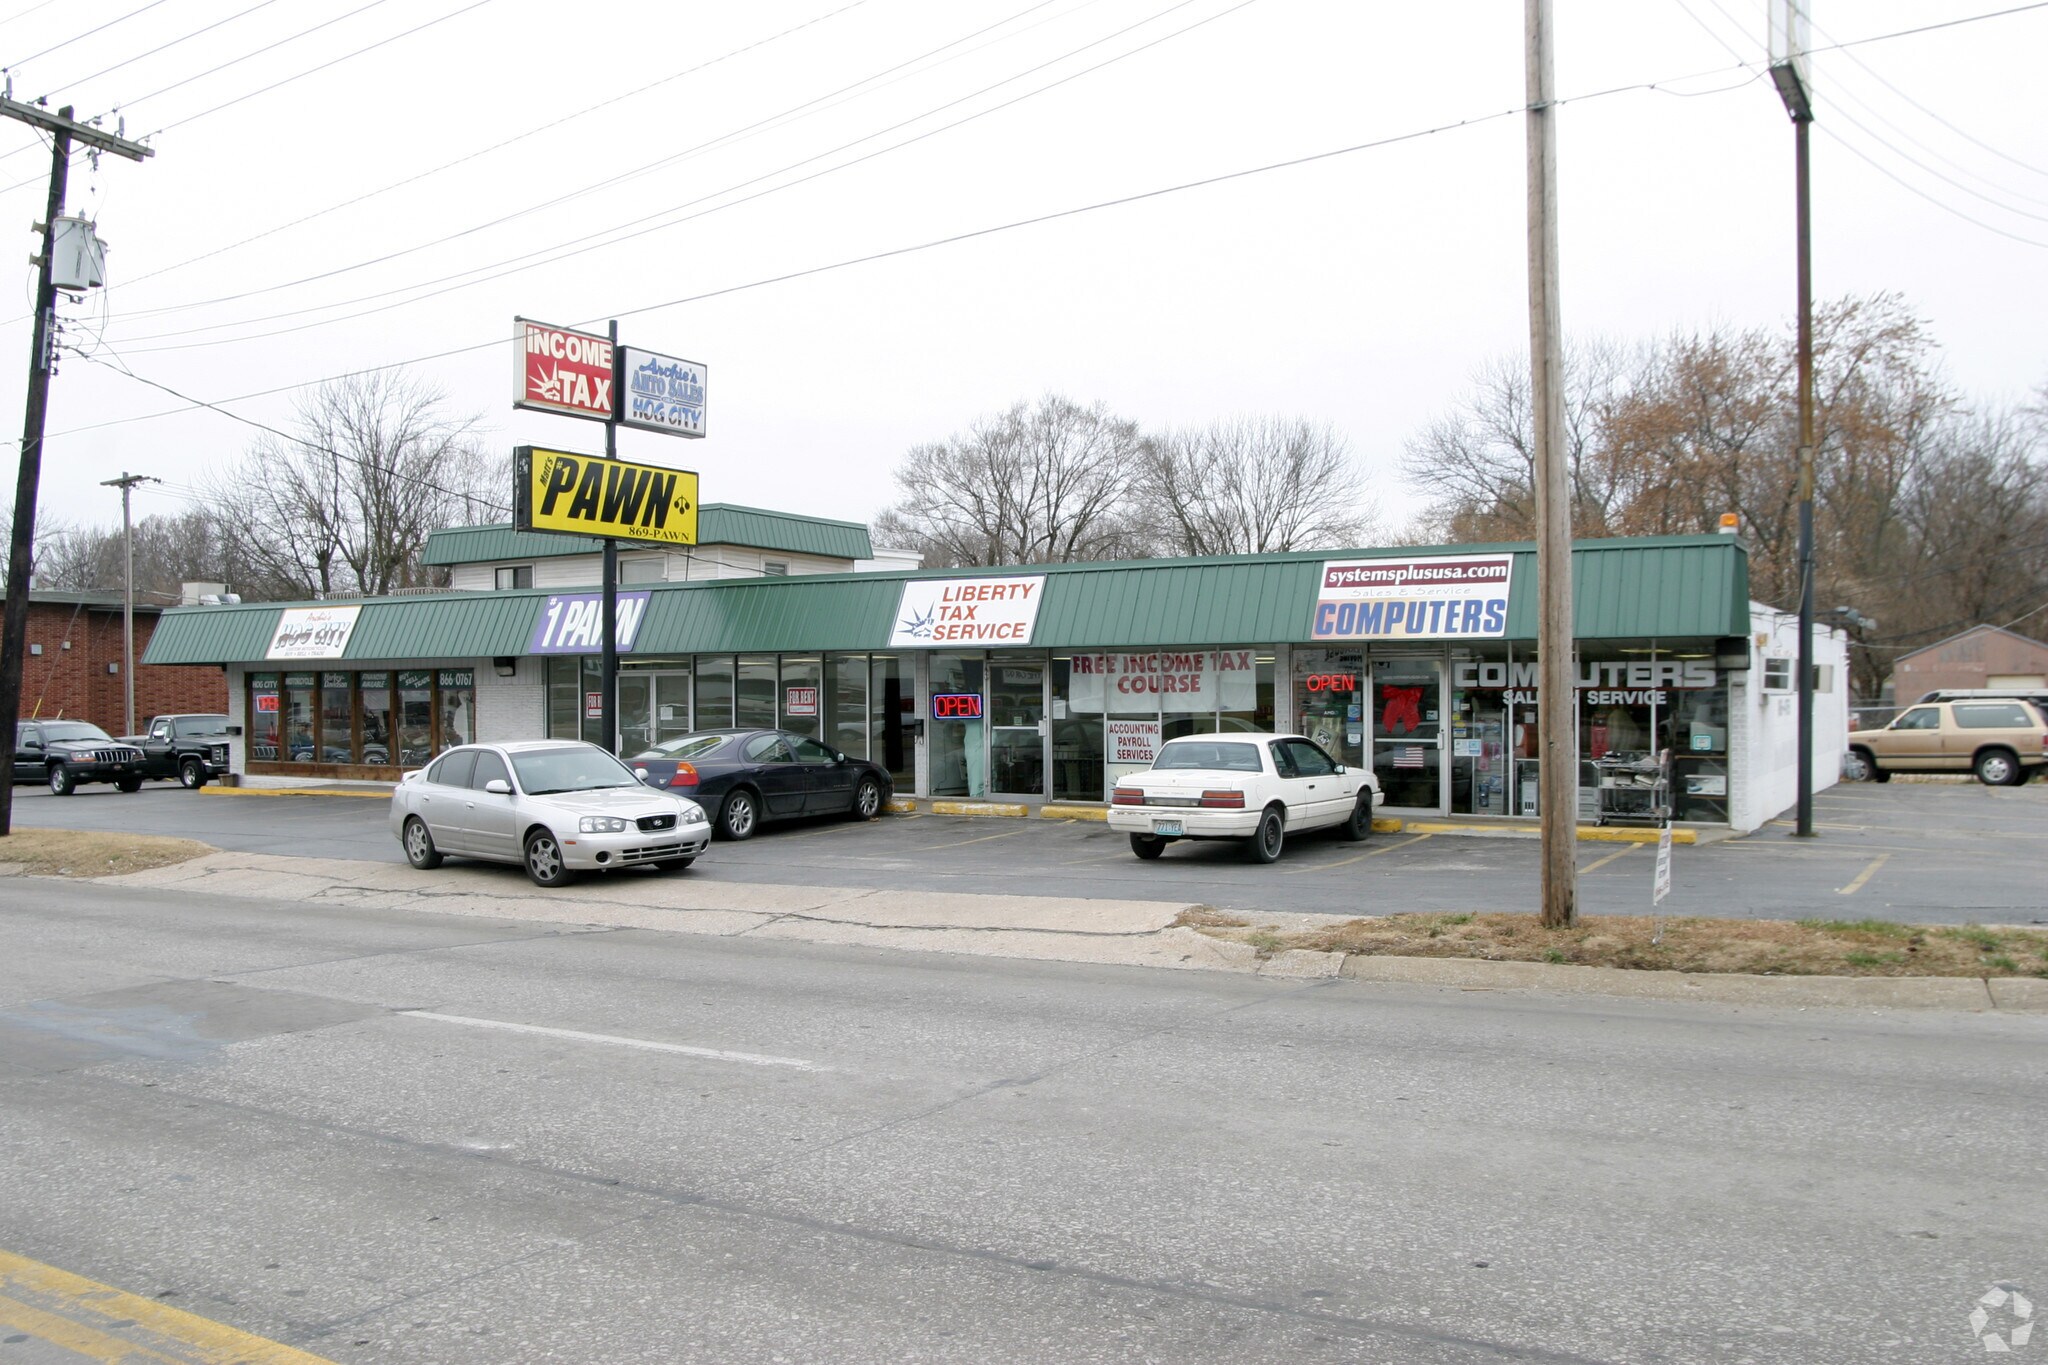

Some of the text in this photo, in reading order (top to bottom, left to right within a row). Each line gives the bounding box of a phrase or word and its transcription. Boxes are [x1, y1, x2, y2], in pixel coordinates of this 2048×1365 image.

[527, 326, 612, 369] INCOME
[639, 357, 698, 384] Archie's
[558, 370, 611, 411] TAX
[631, 369, 704, 404] AUTO SALES
[633, 397, 702, 430] HOG CITY
[540, 457, 554, 487] Matt's
[540, 456, 677, 529] PAWN
[628, 526, 689, 541] 869-PAWN
[1329, 564, 1508, 586] systemsplususa.com
[942, 583, 1036, 602] LIBERTY
[1351, 588, 1392, 598] Sales
[1415, 585, 1473, 596] Service
[939, 605, 978, 621] TAX
[1315, 599, 1507, 636] COMPUTERS
[275, 621, 352, 649] HOG CITY
[932, 622, 1027, 641] SERVICE
[1073, 650, 1251, 674] FREE INCOME TAX
[252, 680, 278, 688] HOG CITY
[440, 673, 472, 686] 866 0767
[1117, 673, 1201, 694] COURSE
[1306, 674, 1356, 691] OPEN
[1454, 661, 1718, 688] COMUTERS
[936, 696, 981, 716] OPEN
[1503, 690, 1667, 705] SAL SERVICE
[1109, 723, 1159, 734] ACCOUNTING
[1118, 736, 1151, 747] PAYROLL
[1117, 749, 1153, 760] SERVICES
